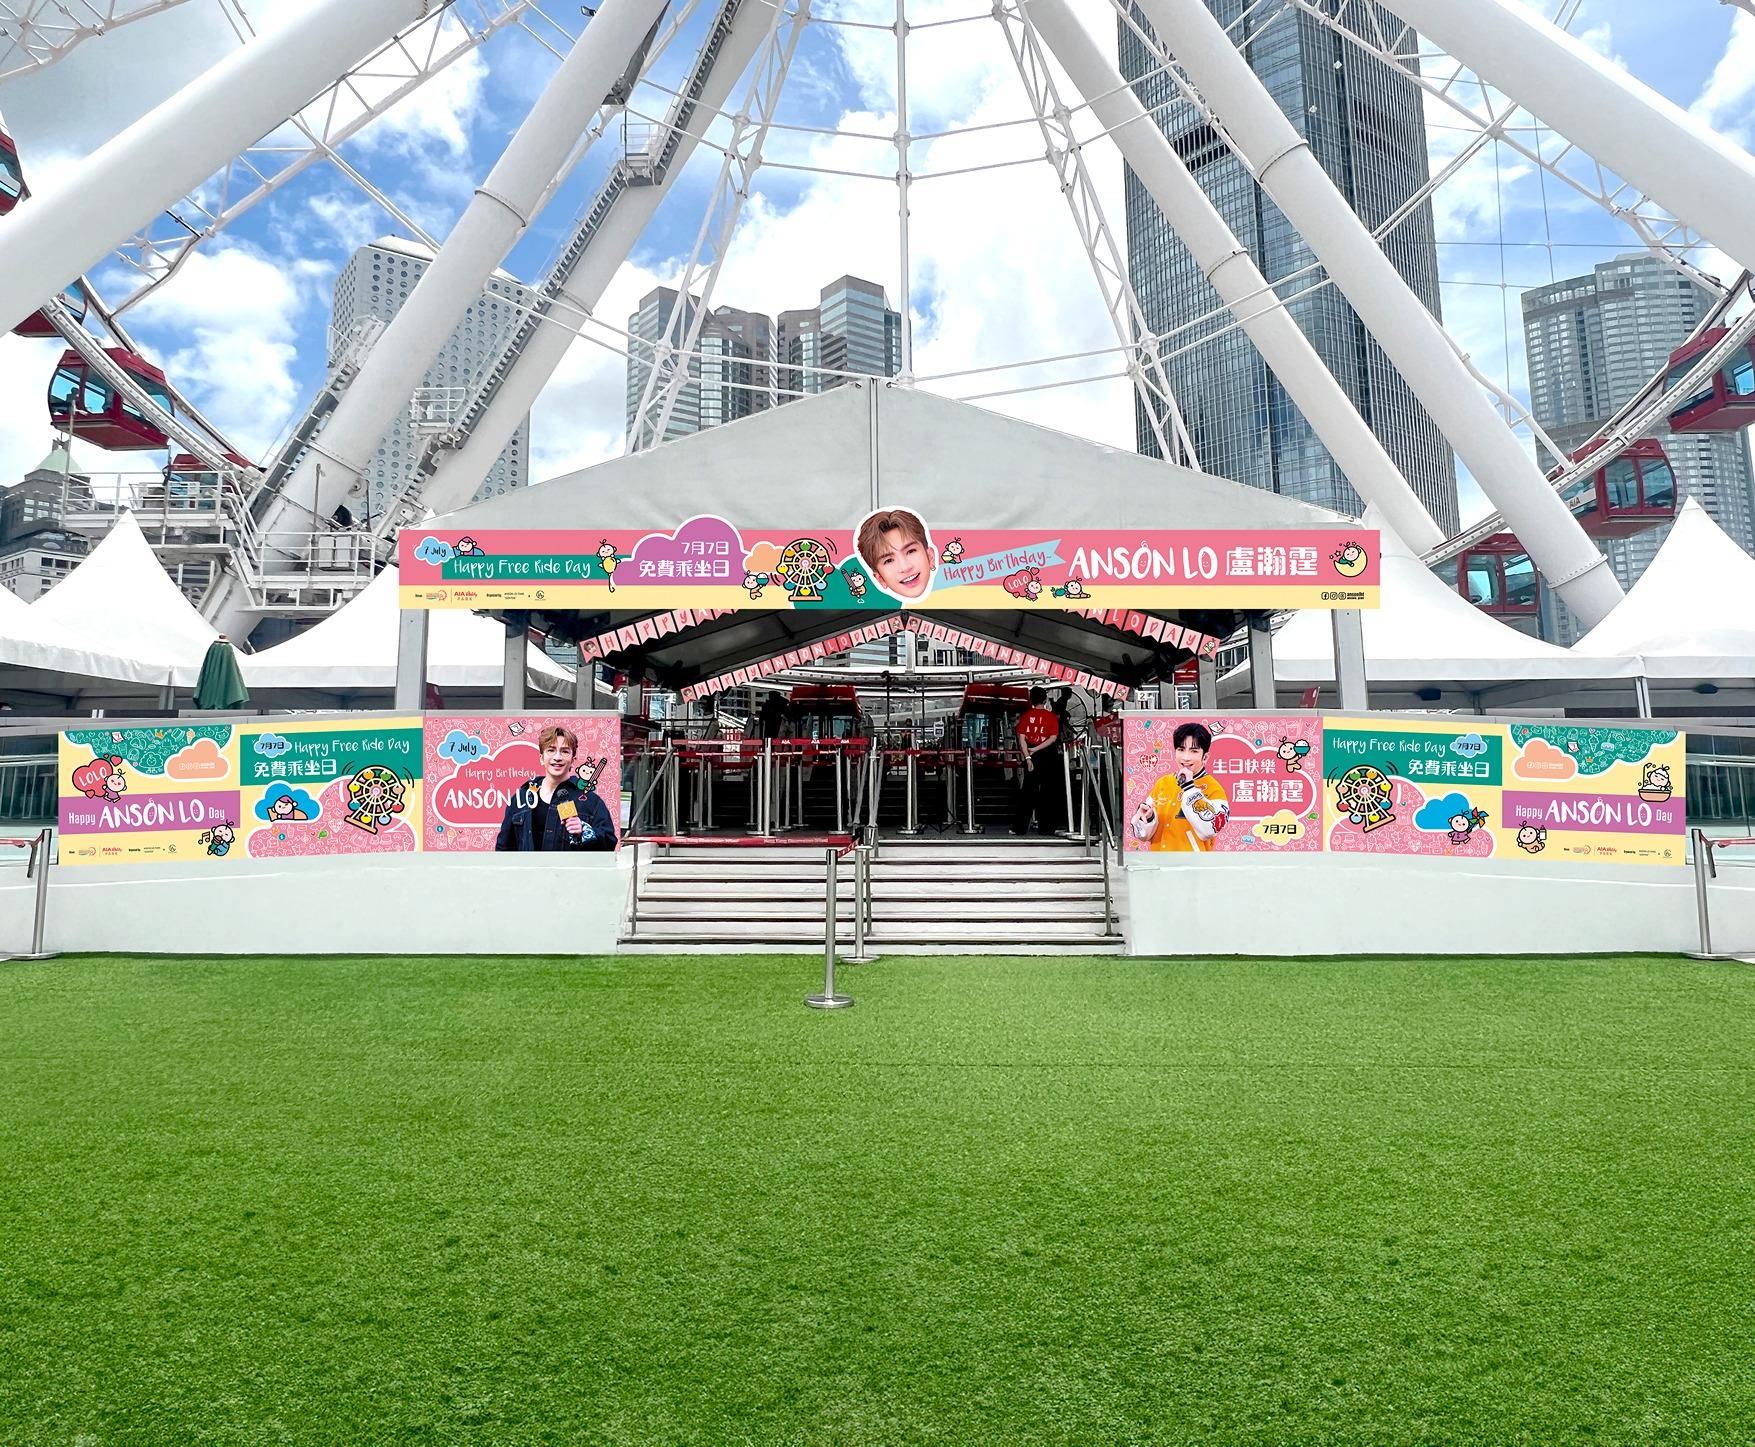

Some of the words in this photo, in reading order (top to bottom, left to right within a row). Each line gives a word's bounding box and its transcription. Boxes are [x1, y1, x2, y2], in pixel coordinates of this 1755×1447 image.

[431, 546, 447, 558] July
[681, 541, 729, 555] 7月7日
[454, 560, 494, 578] Happy
[499, 561, 529, 575] Free
[535, 559, 561, 575] Ride
[566, 560, 591, 578] Day
[639, 560, 730, 578] 免費乘坐日
[1183, 546, 1218, 580] LO
[1226, 546, 1318, 576] 盧瀚霆
[943, 563, 985, 582] Happy
[1008, 575, 1029, 591] LOLO
[295, 741, 329, 757] Happy
[333, 739, 359, 752] Free
[362, 738, 384, 751] Ride
[388, 738, 410, 753] Day
[450, 742, 455, 752] 7
[458, 742, 477, 755] July
[1333, 738, 1366, 754] Happy
[1369, 738, 1396, 752] Free
[1399, 739, 1421, 753] Ride
[1424, 741, 1446, 757] Day
[253, 759, 337, 778] 免費乘坐日
[465, 768, 492, 781] Happy
[1212, 758, 1276, 774] 生日快樂
[1408, 759, 1490, 778] 免費乘坐日
[79, 766, 107, 787] LOLO
[516, 788, 539, 809] LO
[1232, 780, 1304, 803] 盧瀚霆
[68, 811, 96, 826] Happy
[179, 799, 205, 824] LO
[208, 807, 225, 820] Day
[1515, 804, 1543, 819] Happy
[1627, 803, 1652, 827] LO
[1656, 810, 1673, 823] Day
[1262, 824, 1297, 835] 7月7日
